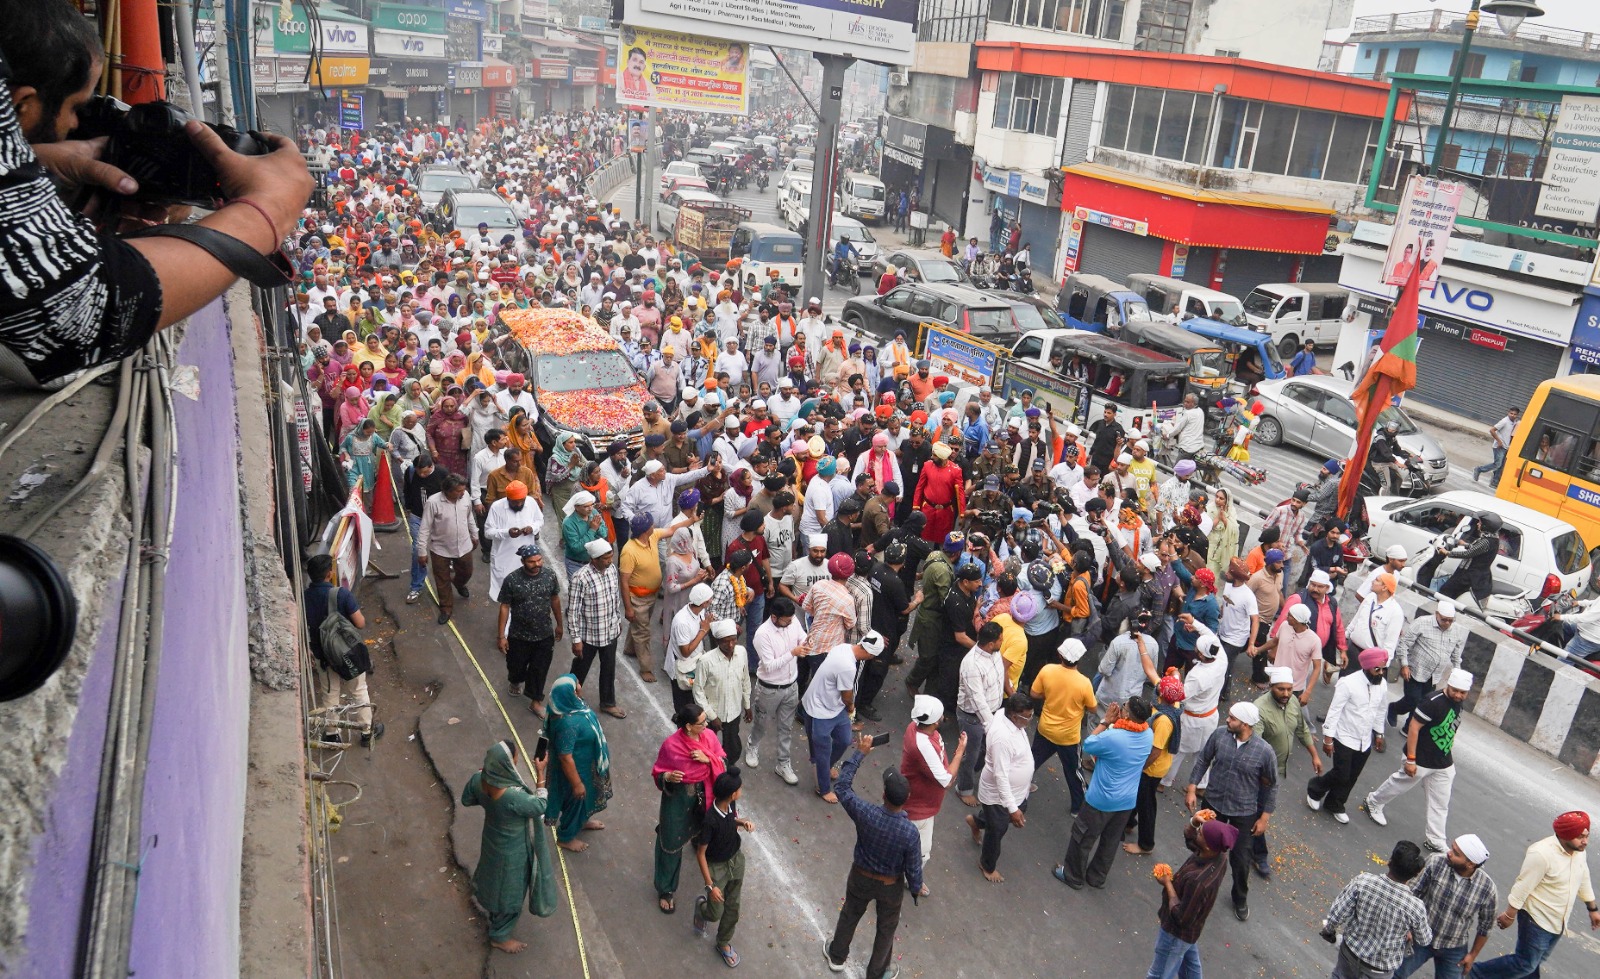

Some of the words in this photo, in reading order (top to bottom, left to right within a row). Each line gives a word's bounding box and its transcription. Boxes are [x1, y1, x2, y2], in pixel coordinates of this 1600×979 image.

[726, 2, 744, 10] Liberal
[744, 5, 764, 14] Studies
[398, 12, 428, 27] oppo
[688, 6, 712, 15] Forestry
[718, 10, 745, 20] Pharmacy
[763, 17, 784, 26] Medical
[788, 21, 816, 31] Hospitality
[326, 25, 357, 43] vivo
[402, 36, 424, 52] vivo
[329, 64, 357, 77] realme
[406, 68, 428, 77] SAMSUNG
[1564, 102, 1580, 111] Free
[1557, 137, 1570, 145] Our
[1555, 152, 1592, 164] Cleaning/
[1553, 163, 1598, 177] Disinfecting
[1550, 174, 1578, 184] Repair/
[1545, 194, 1562, 202] Color
[1563, 196, 1596, 207] Correction
[1543, 203, 1585, 216] Restoration
[1361, 303, 1384, 314] SAMSUNG
[1435, 322, 1460, 336] iPhone
[1507, 319, 1523, 328] Planet
[1524, 322, 1541, 332] Mobile
[1542, 328, 1562, 338] Gallery
[1480, 337, 1504, 346] ONEPLUS
[1578, 489, 1600, 505] SHR
